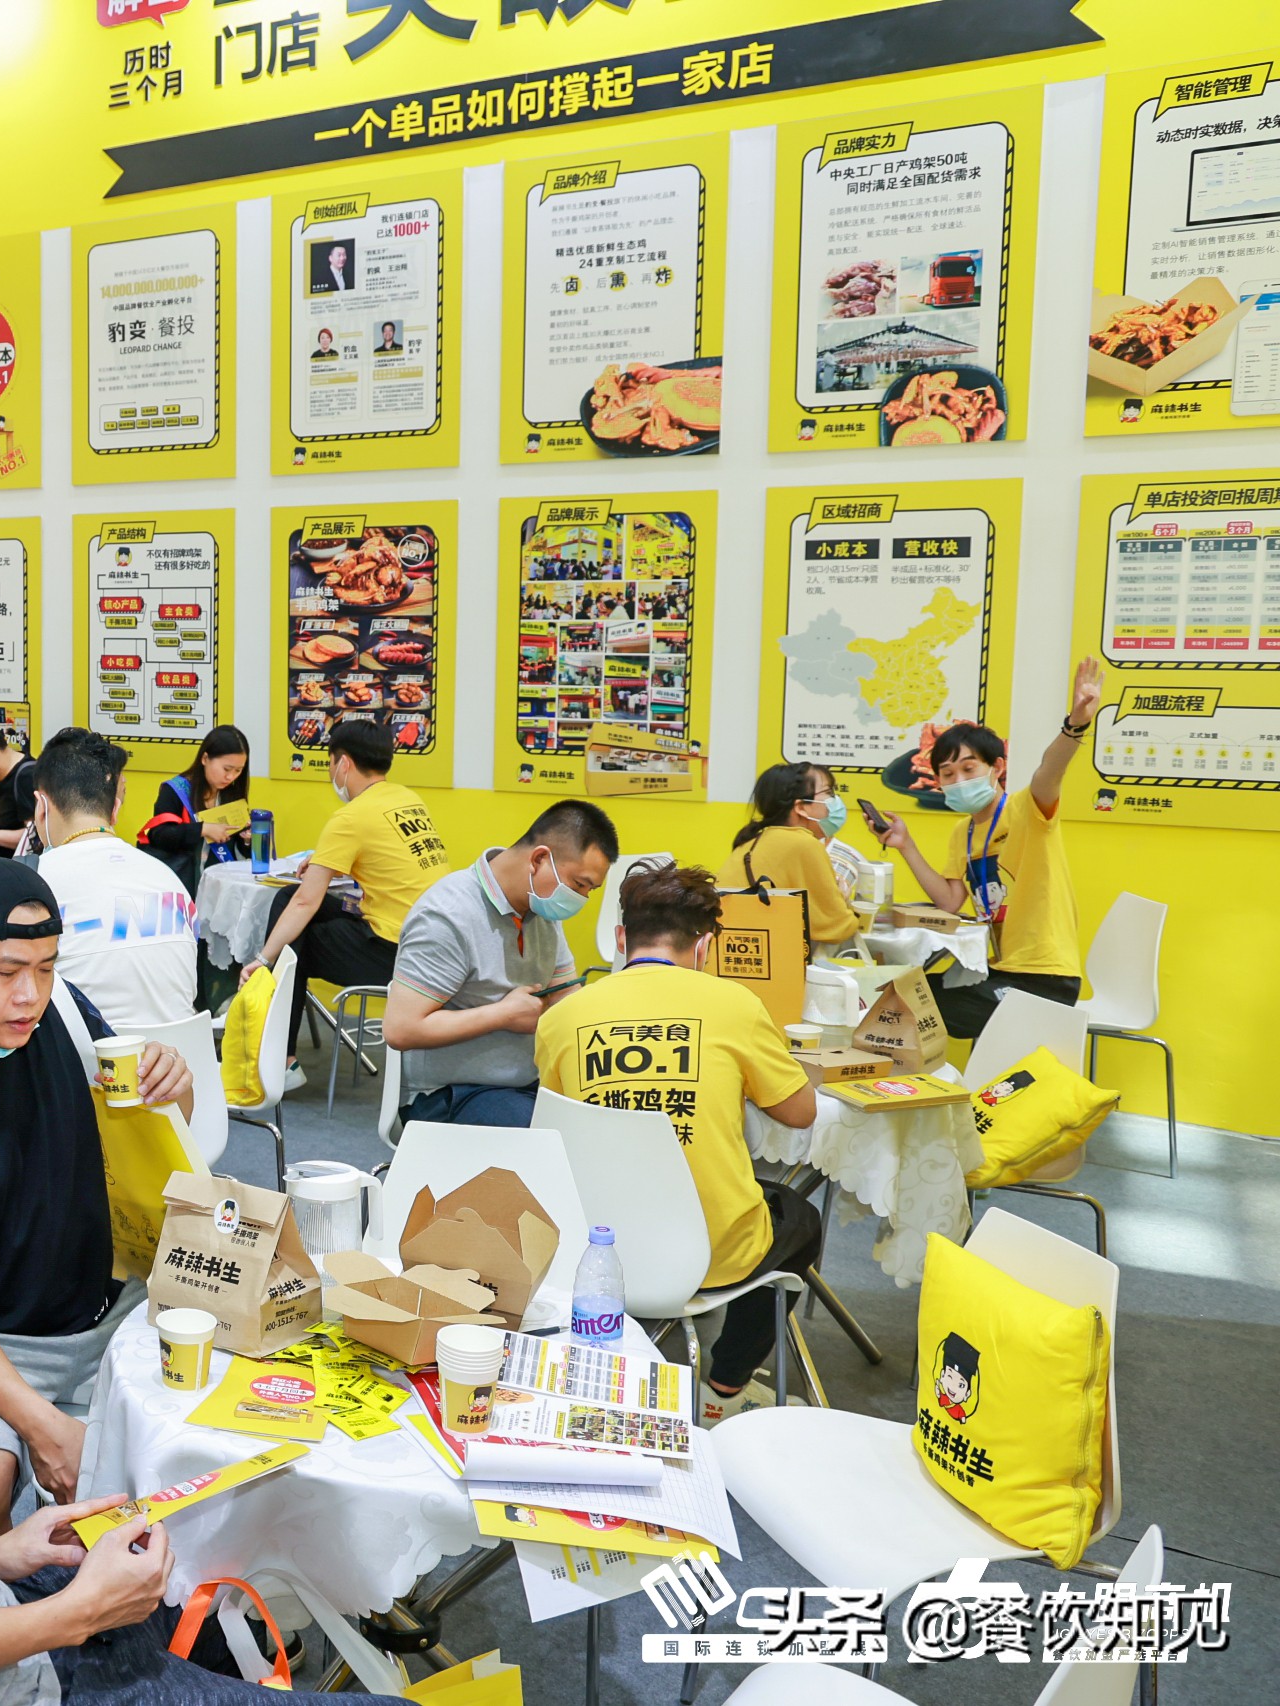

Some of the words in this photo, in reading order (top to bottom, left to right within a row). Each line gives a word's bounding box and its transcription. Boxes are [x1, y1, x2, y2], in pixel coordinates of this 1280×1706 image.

[214, 10, 320, 87] 门店
[123, 41, 172, 76] 历时
[108, 70, 182, 108] 三个月
[313, 41, 774, 144] 一个单品如何撑起一家店
[1174, 74, 1254, 102] 智能管理
[833, 132, 897, 156] 品牌实力
[829, 151, 968, 182] 中央工厂日产鸡架50吨
[553, 170, 607, 190] 品牌介绍
[845, 166, 983, 197] 同时满足全国配货需求
[312, 203, 359, 220] 创始团队
[381, 209, 430, 224] 我们连锁门店
[555, 239, 648, 258] 精选优质新鲜生态鸡
[579, 250, 668, 269] 24重烹制工艺流程
[120, 344, 151, 355] LEOPARD
[153, 342, 182, 352] CHANGE
[1150, 401, 1203, 414] 麻辣书生
[547, 508, 600, 521] 品牌展示
[822, 503, 882, 519] 区域招商
[107, 528, 147, 541] 产品结构
[310, 522, 356, 535] 产品展示
[146, 548, 202, 560] 不仅有招牌鸡架
[816, 542, 868, 558] 小成本
[904, 540, 959, 556] 营收快
[154, 561, 211, 571] 还有很多好吃的
[104, 599, 138, 610] 核心产品
[164, 606, 194, 617] 主食类
[296, 599, 340, 612] 手撕鸡架
[106, 657, 134, 667] 小吃类
[162, 675, 191, 685] 饮品类
[1132, 694, 1205, 712] 加盟流程
[1123, 796, 1173, 808] 麻辣书生
[726, 936, 760, 944] 人气美食
[726, 943, 761, 955] NO.1
[724, 957, 763, 967] 手撕鸡架
[585, 1024, 693, 1050] 人气美食
[864, 1034, 904, 1047] 麻辣书生
[585, 1045, 692, 1080] NO.1
[840, 1066, 876, 1076] 麻辣书生
[233, 1228, 260, 1241] 手撕鸡架
[164, 1246, 242, 1286] 麻辣书生
[265, 1310, 309, 1333] 400-1515-767
[919, 1408, 995, 1482] 麻辣书生
